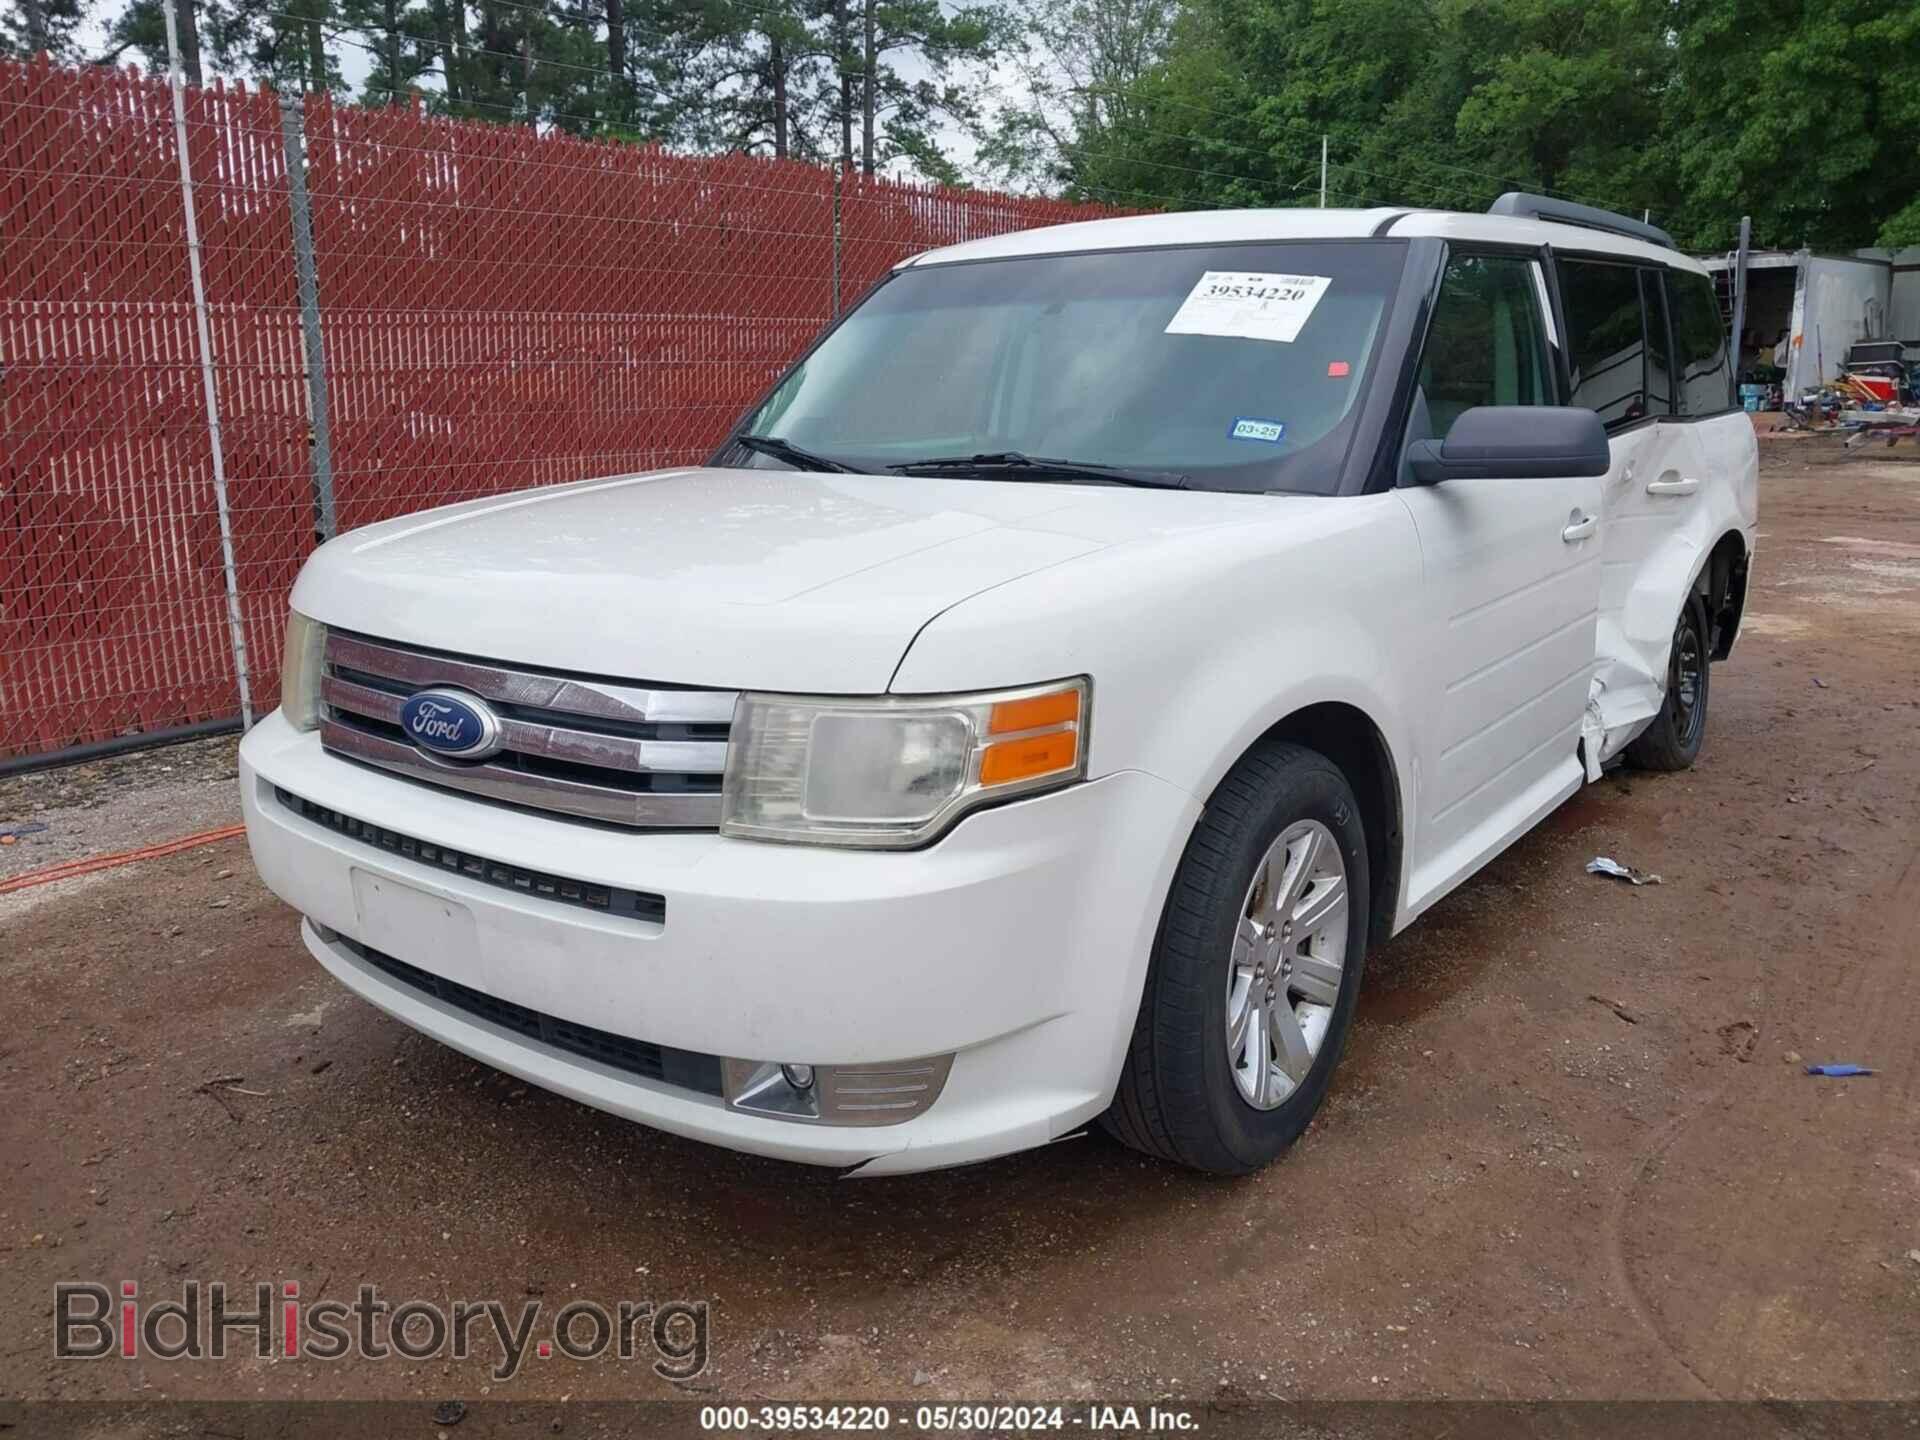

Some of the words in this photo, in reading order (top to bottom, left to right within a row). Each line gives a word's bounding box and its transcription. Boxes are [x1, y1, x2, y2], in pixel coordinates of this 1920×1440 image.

[1203, 285, 1305, 301] 39534220
[1237, 423, 1280, 437] 03-25
[412, 701, 464, 741] Ford
